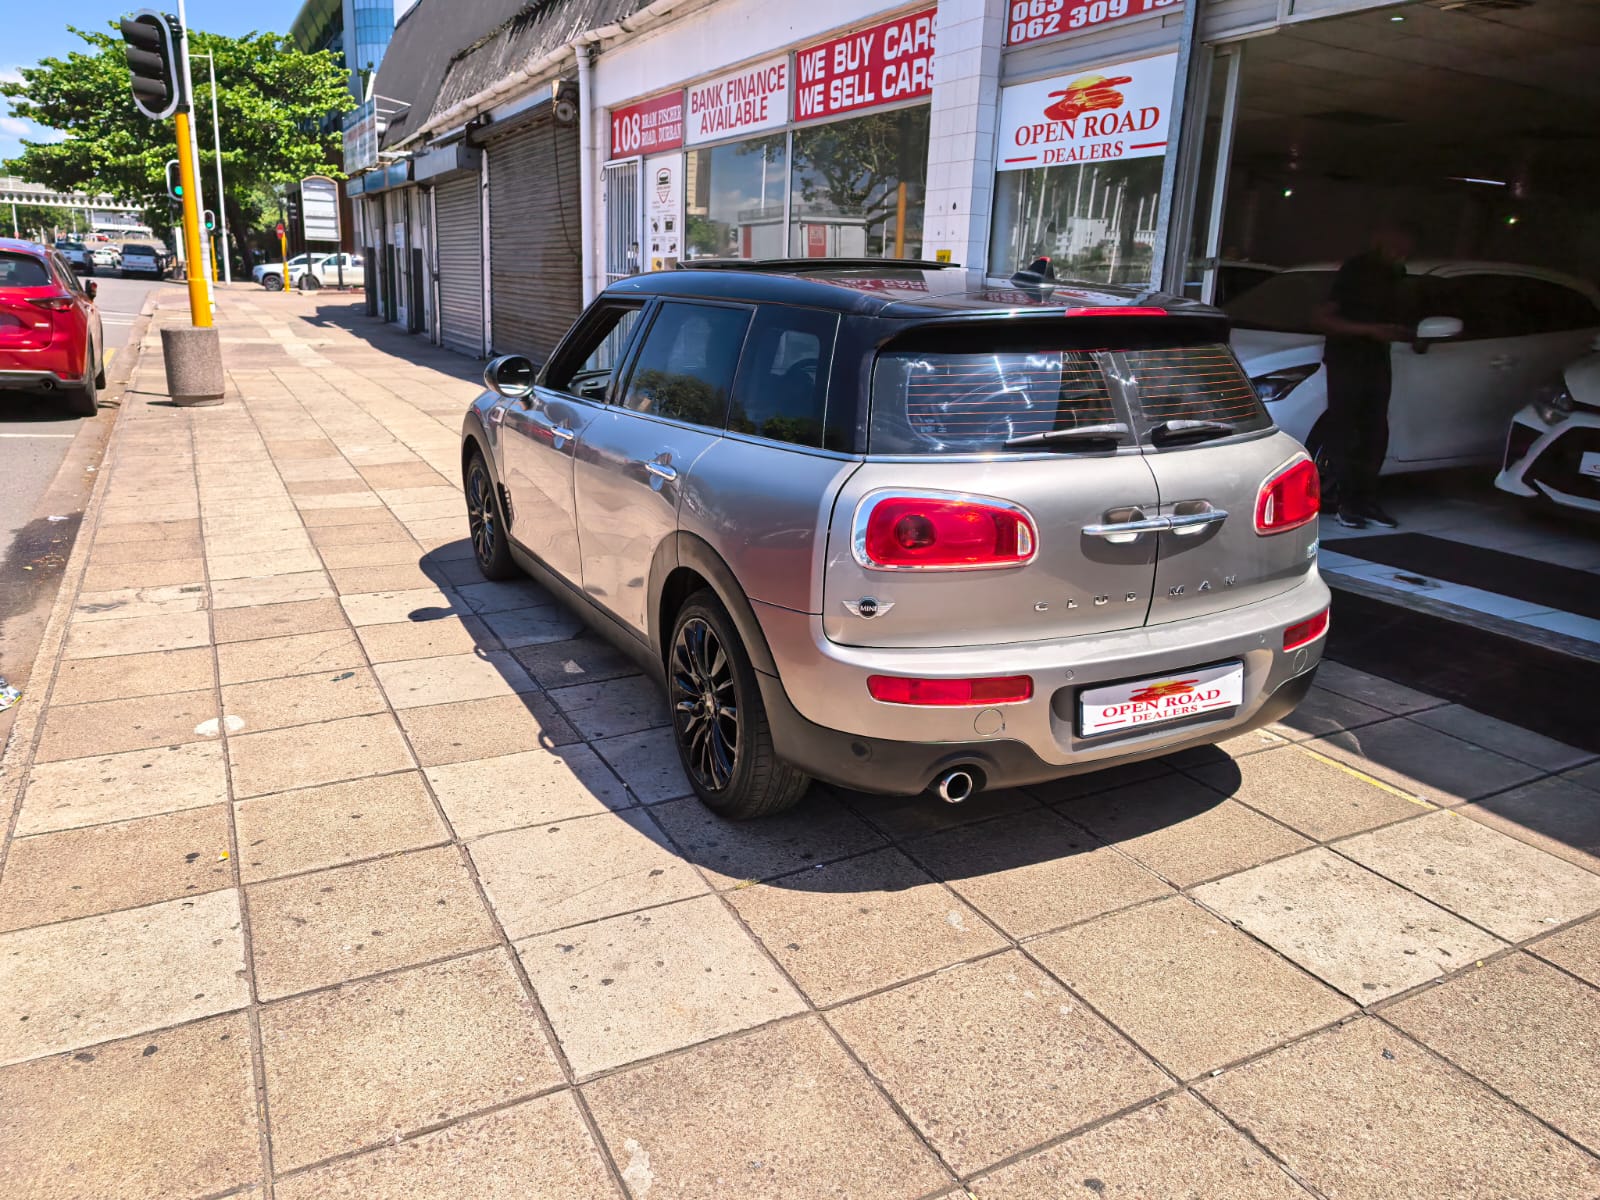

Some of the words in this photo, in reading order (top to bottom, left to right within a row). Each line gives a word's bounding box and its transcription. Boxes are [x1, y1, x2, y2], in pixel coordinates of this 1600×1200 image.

[1010, 13, 1062, 43] 062
[1069, 0, 1129, 28] 309
[800, 49, 826, 84] WE
[833, 33, 875, 75] BUY
[691, 83, 723, 115] BANK
[726, 63, 786, 105] FINANCE
[799, 83, 825, 117] WE
[829, 71, 875, 110] SELL
[613, 113, 641, 154] 108
[700, 95, 768, 135] AVAILABLE
[1014, 118, 1078, 147] OPEN
[1082, 106, 1161, 138] ROAD
[1042, 140, 1124, 164] DEALERS
[860, 604, 878, 612] MINI
[1102, 699, 1159, 718] OPEN
[1164, 689, 1221, 708] ROAD
[1132, 704, 1198, 723] DEALERS
